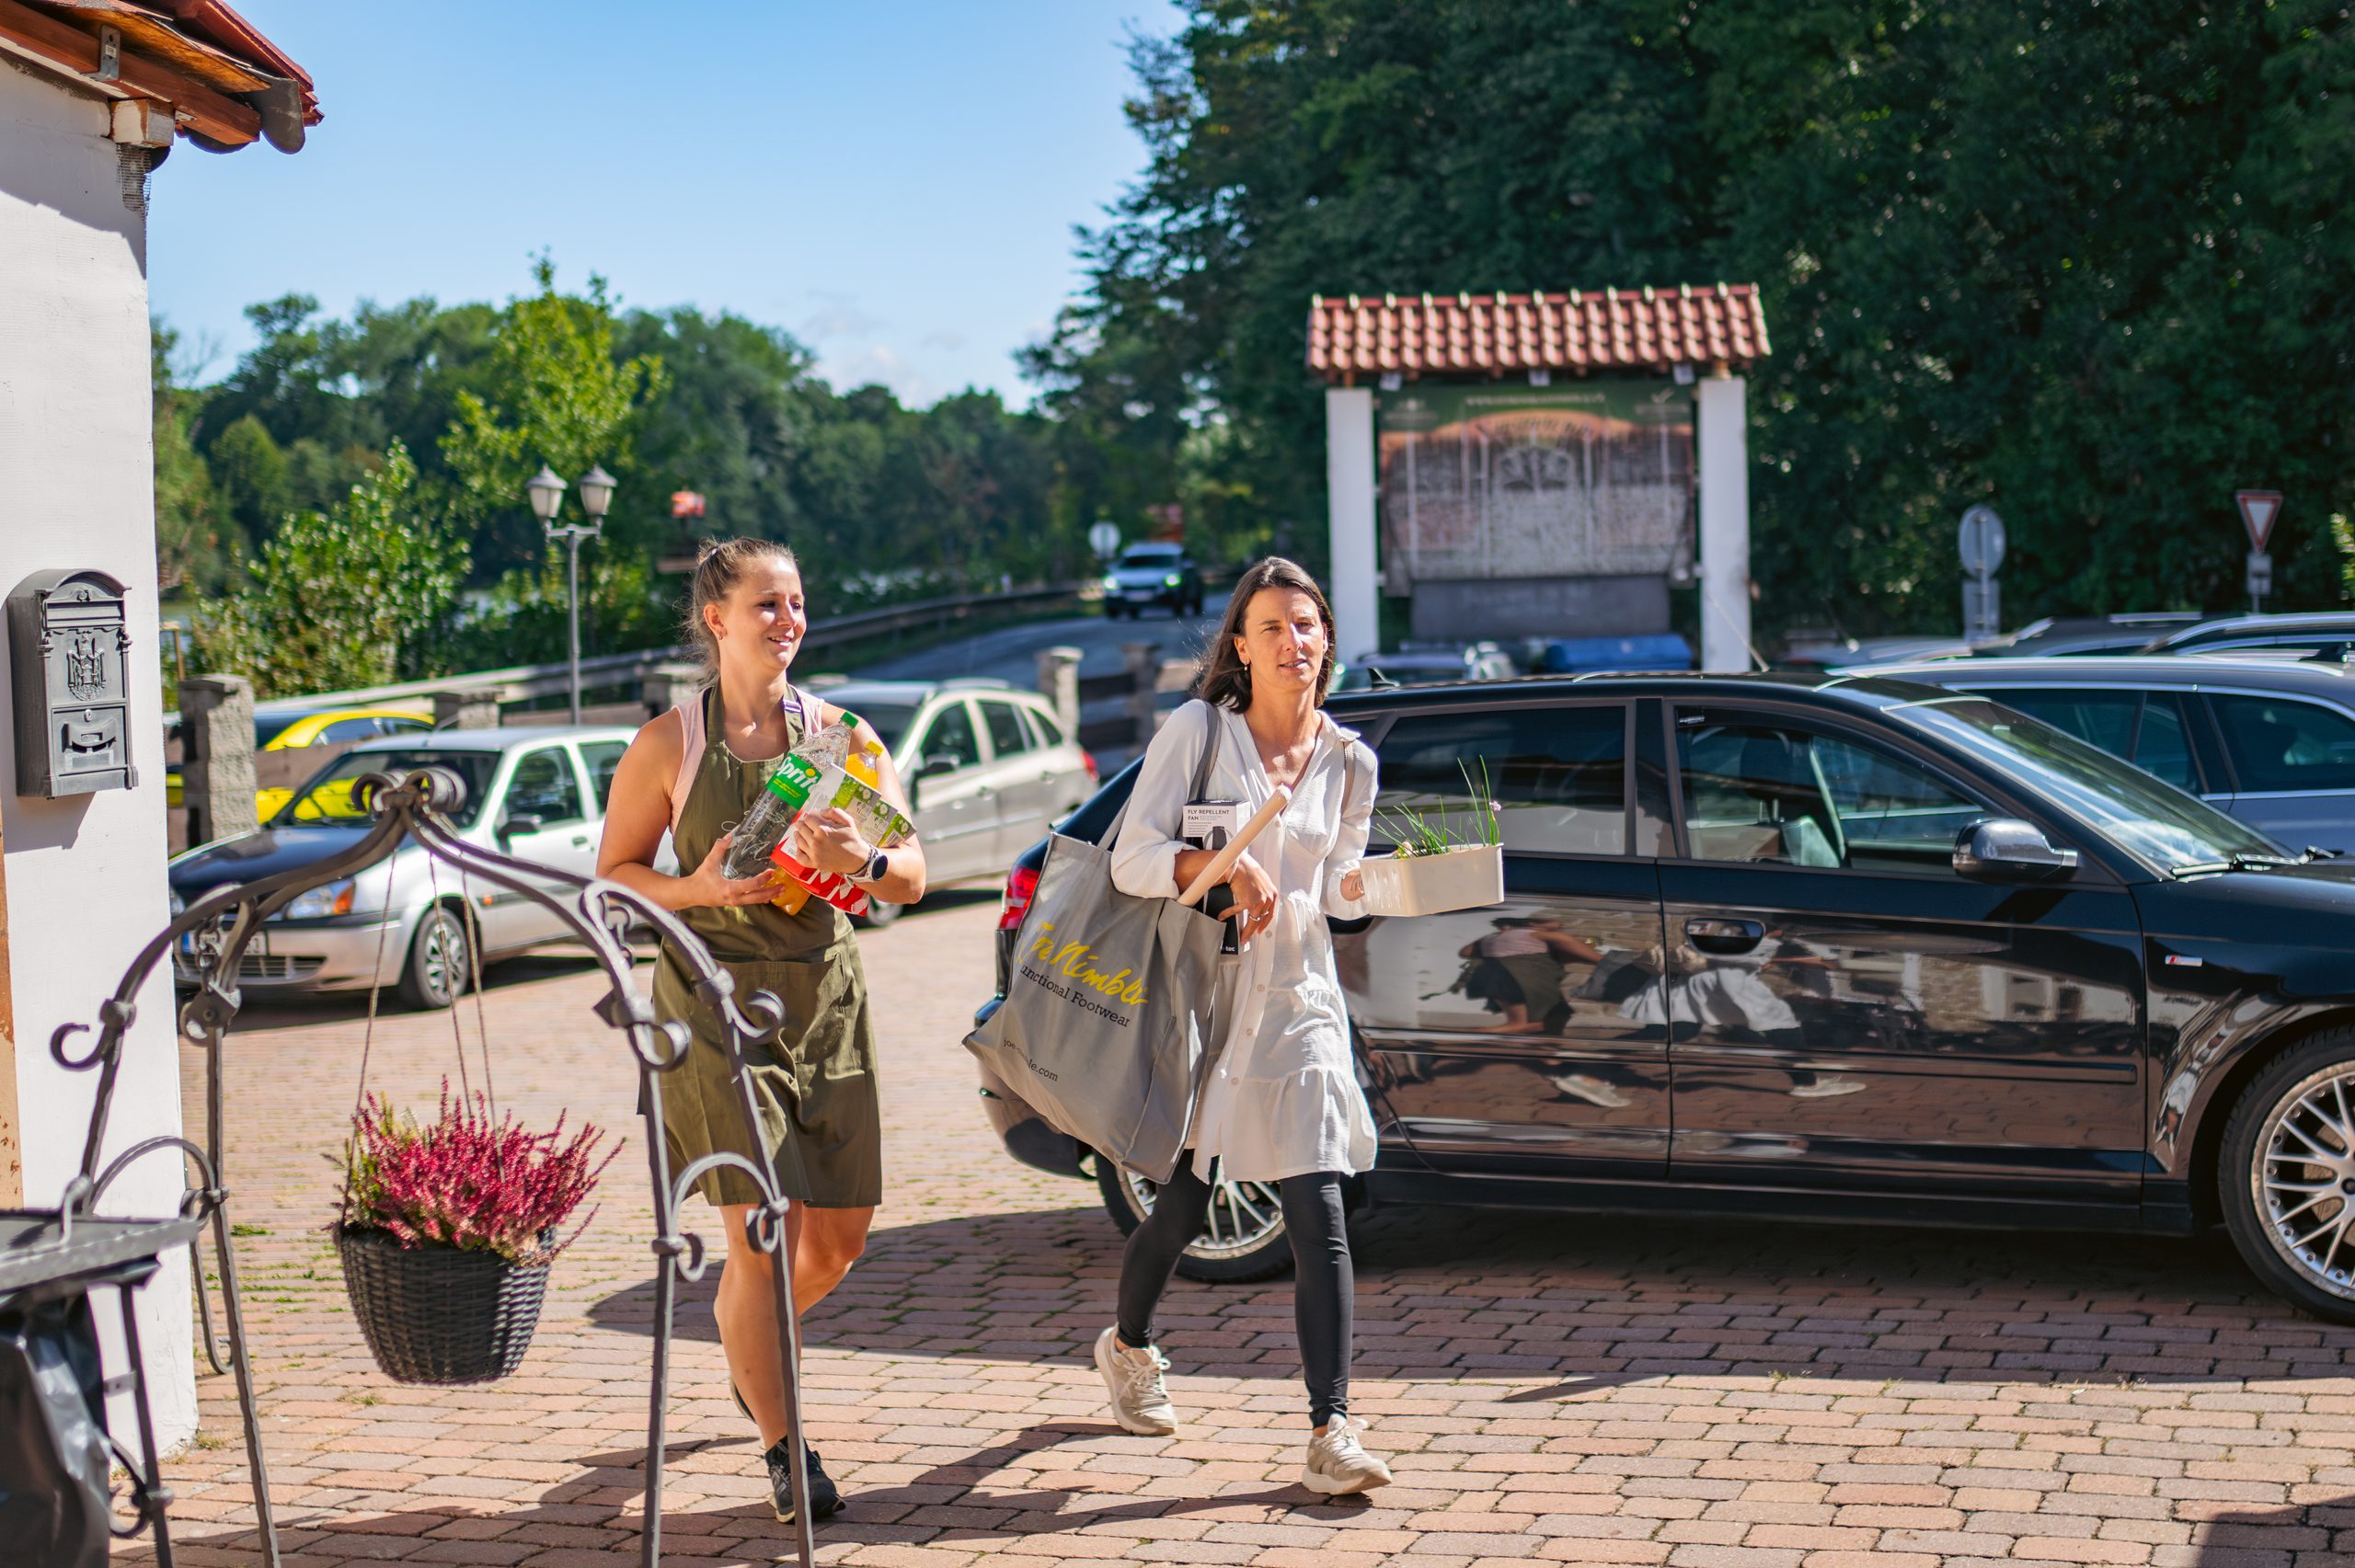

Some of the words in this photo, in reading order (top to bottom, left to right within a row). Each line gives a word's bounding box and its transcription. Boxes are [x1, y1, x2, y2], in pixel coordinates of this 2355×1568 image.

[776, 756, 818, 794] Sprit
[1019, 964, 1071, 1000] unctional
[1071, 990, 1131, 1027] Footwear
